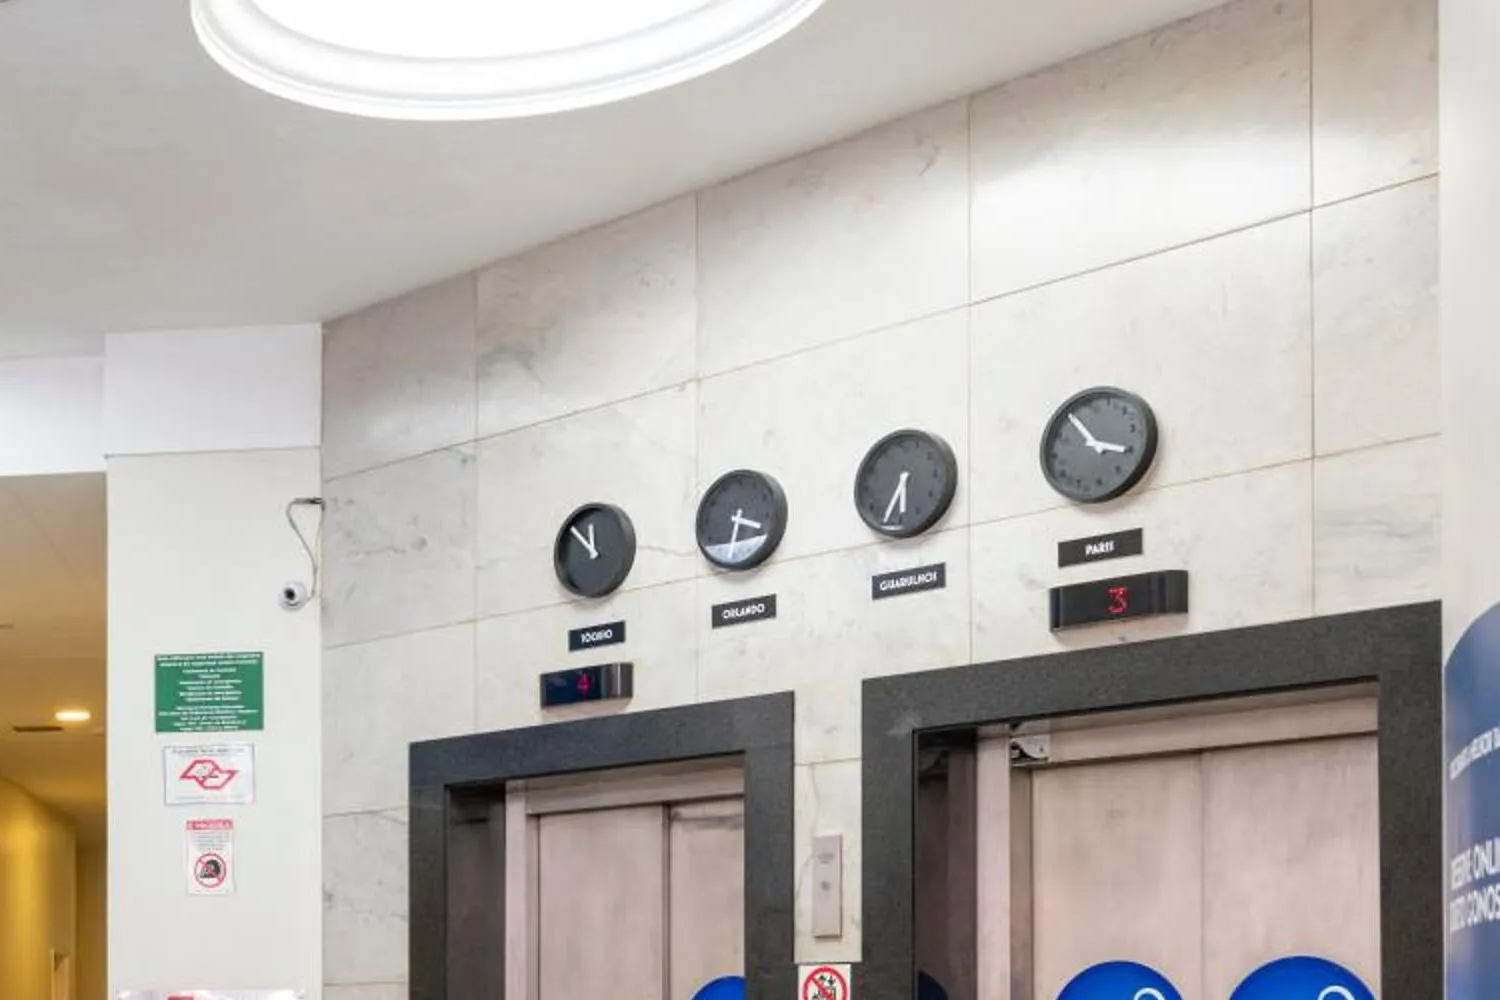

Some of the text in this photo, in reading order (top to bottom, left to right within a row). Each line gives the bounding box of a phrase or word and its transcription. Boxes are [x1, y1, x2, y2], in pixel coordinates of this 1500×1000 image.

[1084, 540, 1115, 556] PARIS
[879, 570, 938, 591] GUARULHOS
[1107, 586, 1127, 614] 3
[721, 603, 766, 621] ORLANDO
